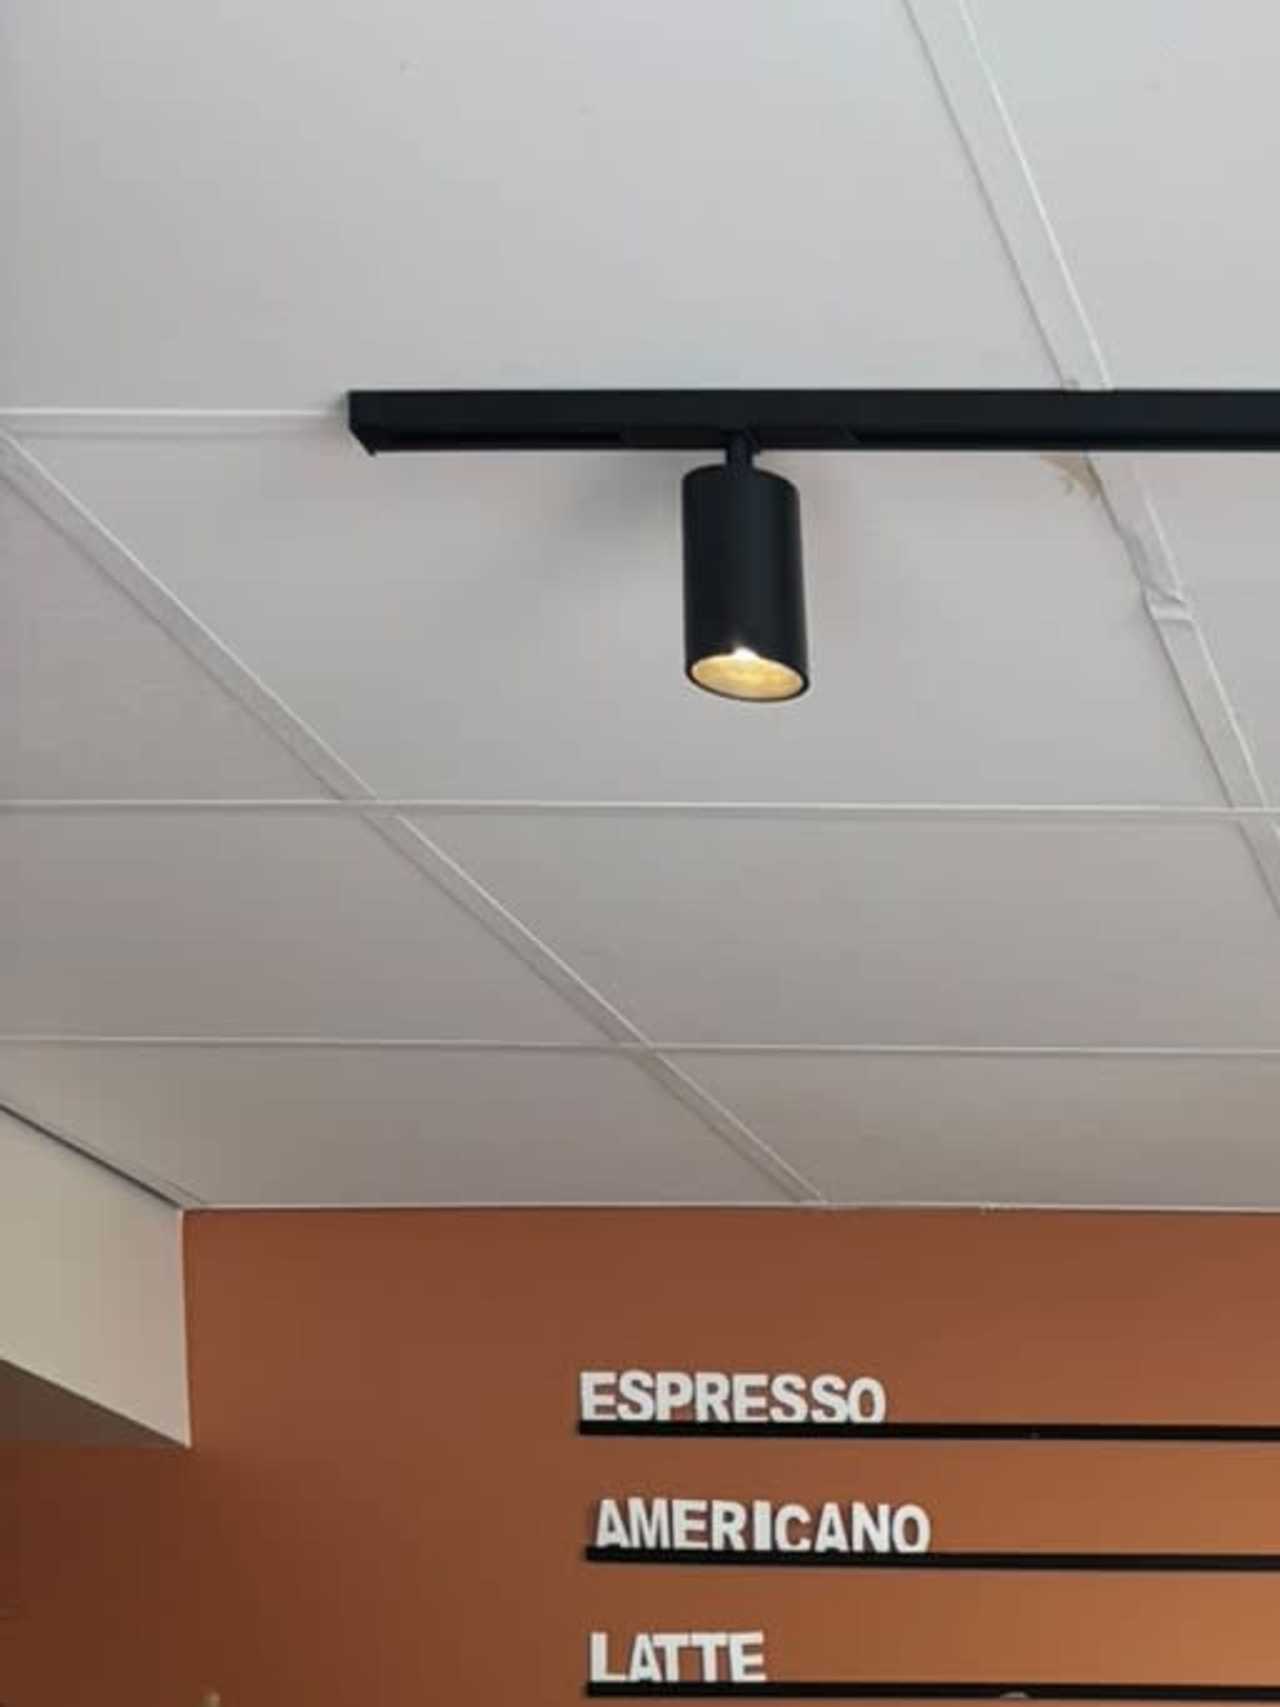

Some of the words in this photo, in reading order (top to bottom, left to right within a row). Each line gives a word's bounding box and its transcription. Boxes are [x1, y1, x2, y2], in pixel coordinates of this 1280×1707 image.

[580, 1370, 886, 1423] ESPRESSO
[597, 1498, 930, 1553] AMERICANO
[591, 1632, 766, 1682] LATTE
